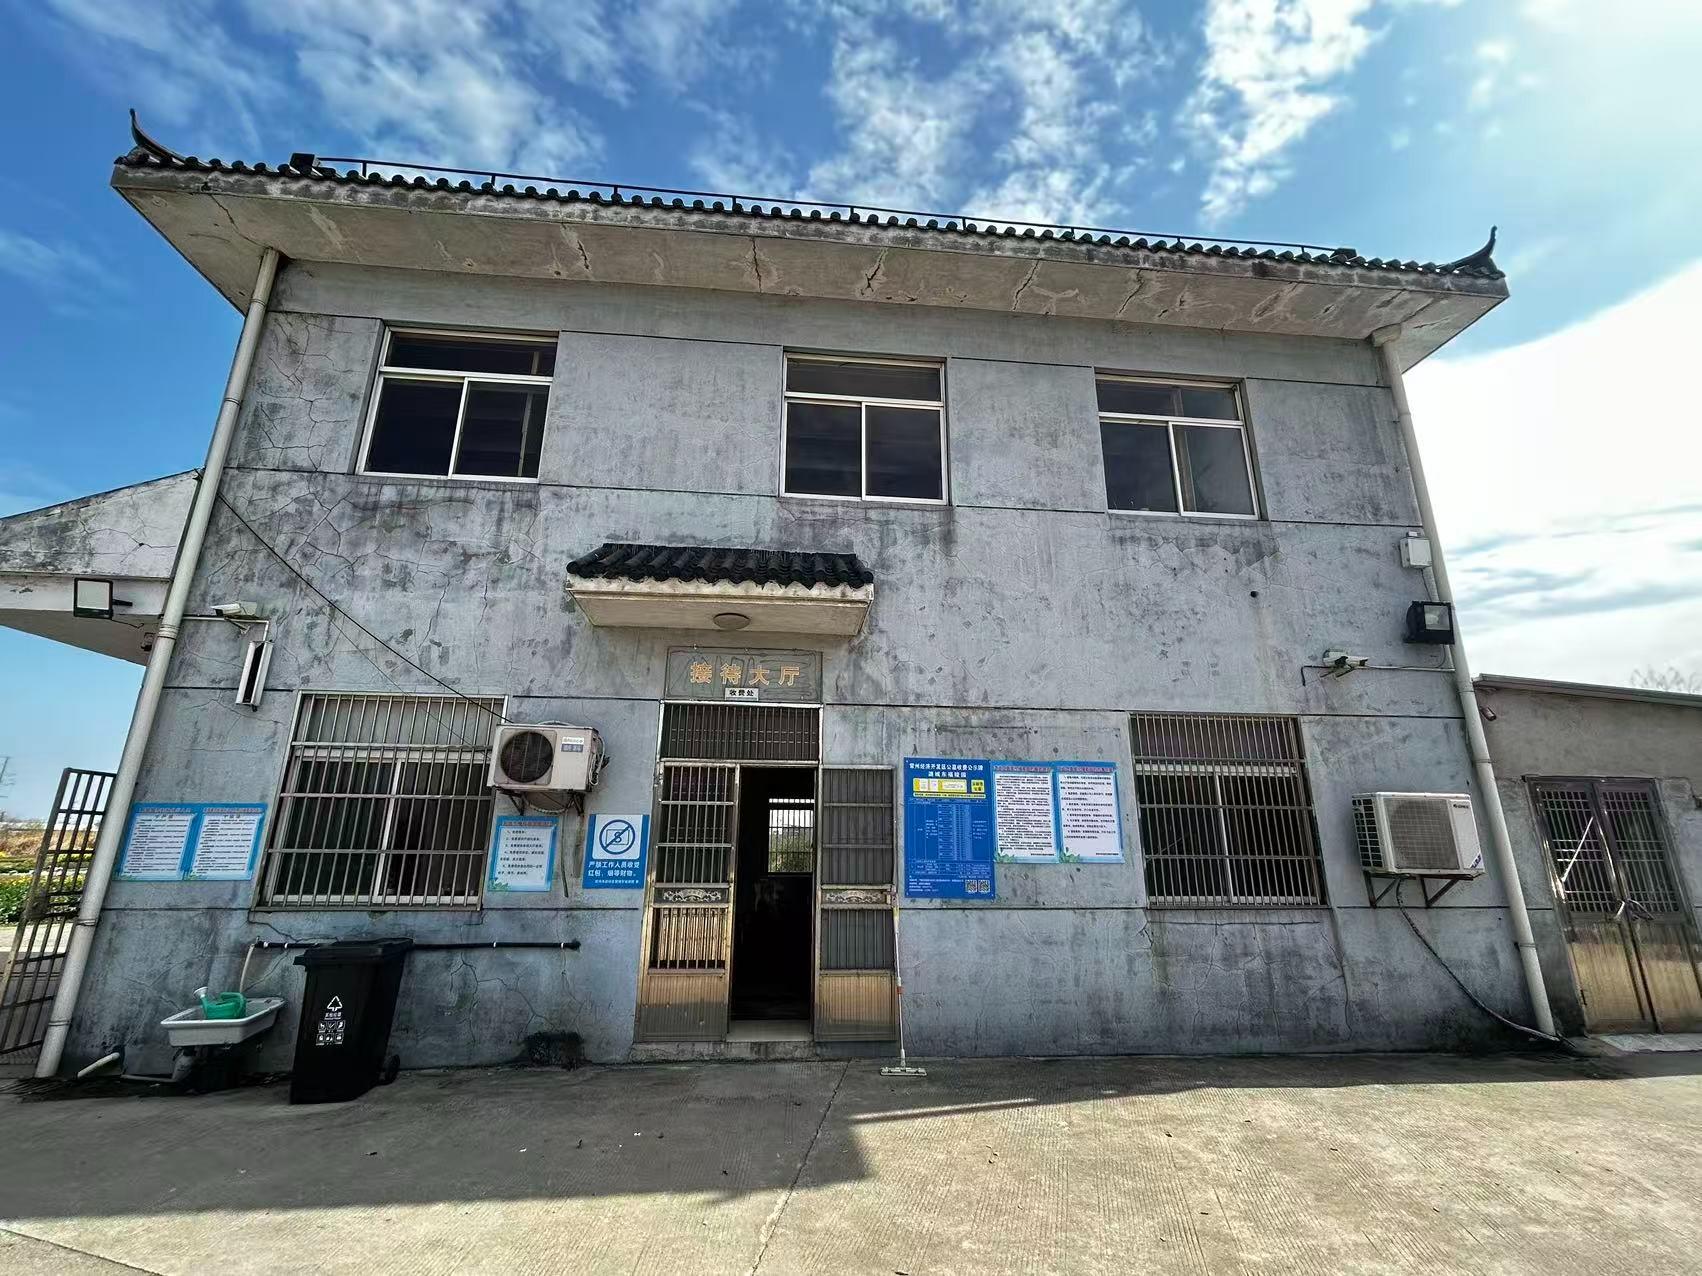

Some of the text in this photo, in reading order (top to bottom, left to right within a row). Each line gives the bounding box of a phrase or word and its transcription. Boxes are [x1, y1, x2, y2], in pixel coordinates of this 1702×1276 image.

[689, 661, 800, 687] 接待大厅
[729, 689, 755, 697] 收费处
[588, 861, 640, 869] 严禁工作人员收受
